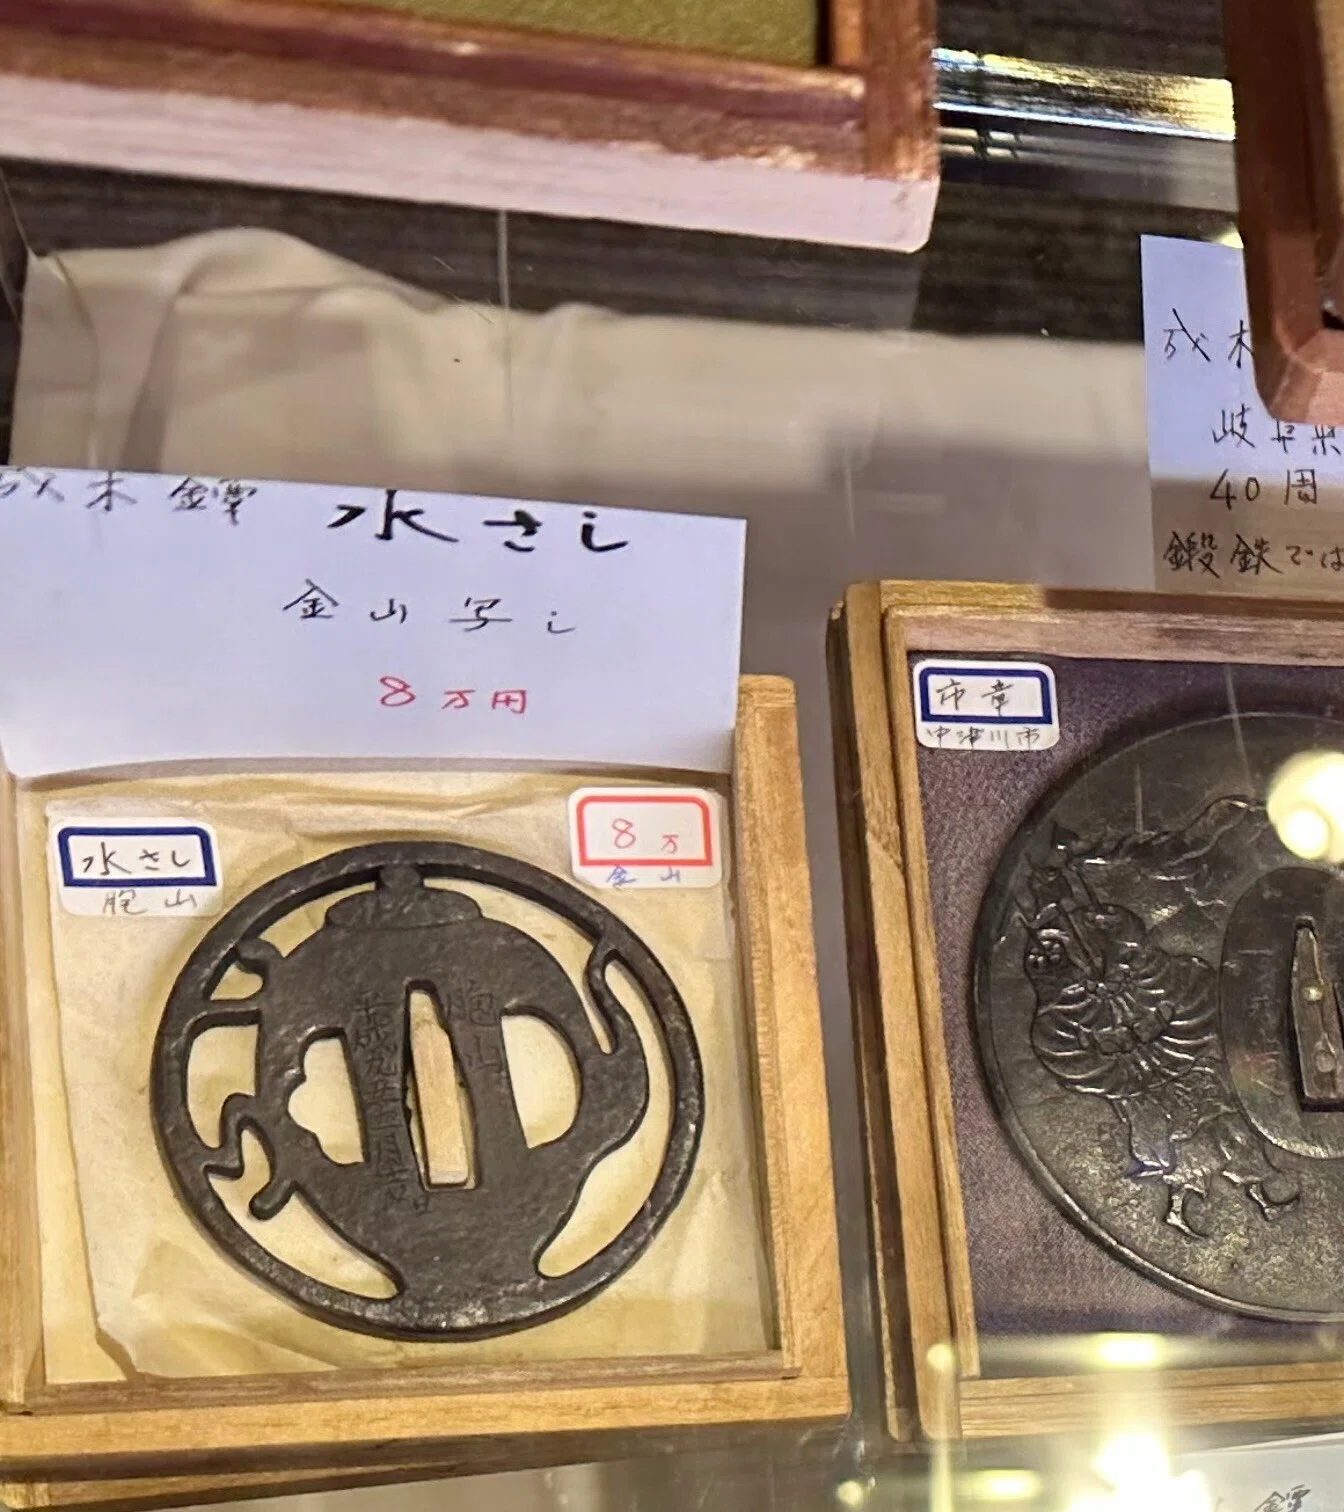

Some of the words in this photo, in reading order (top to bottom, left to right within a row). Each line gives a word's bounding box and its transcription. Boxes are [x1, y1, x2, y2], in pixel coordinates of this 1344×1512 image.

[327, 489, 629, 554] 水さし
[281, 579, 577, 636] 金山写し
[377, 675, 530, 716] 8万円
[925, 724, 1041, 750] 中津川市
[610, 817, 679, 855] 8万
[81, 840, 192, 876] 水さし
